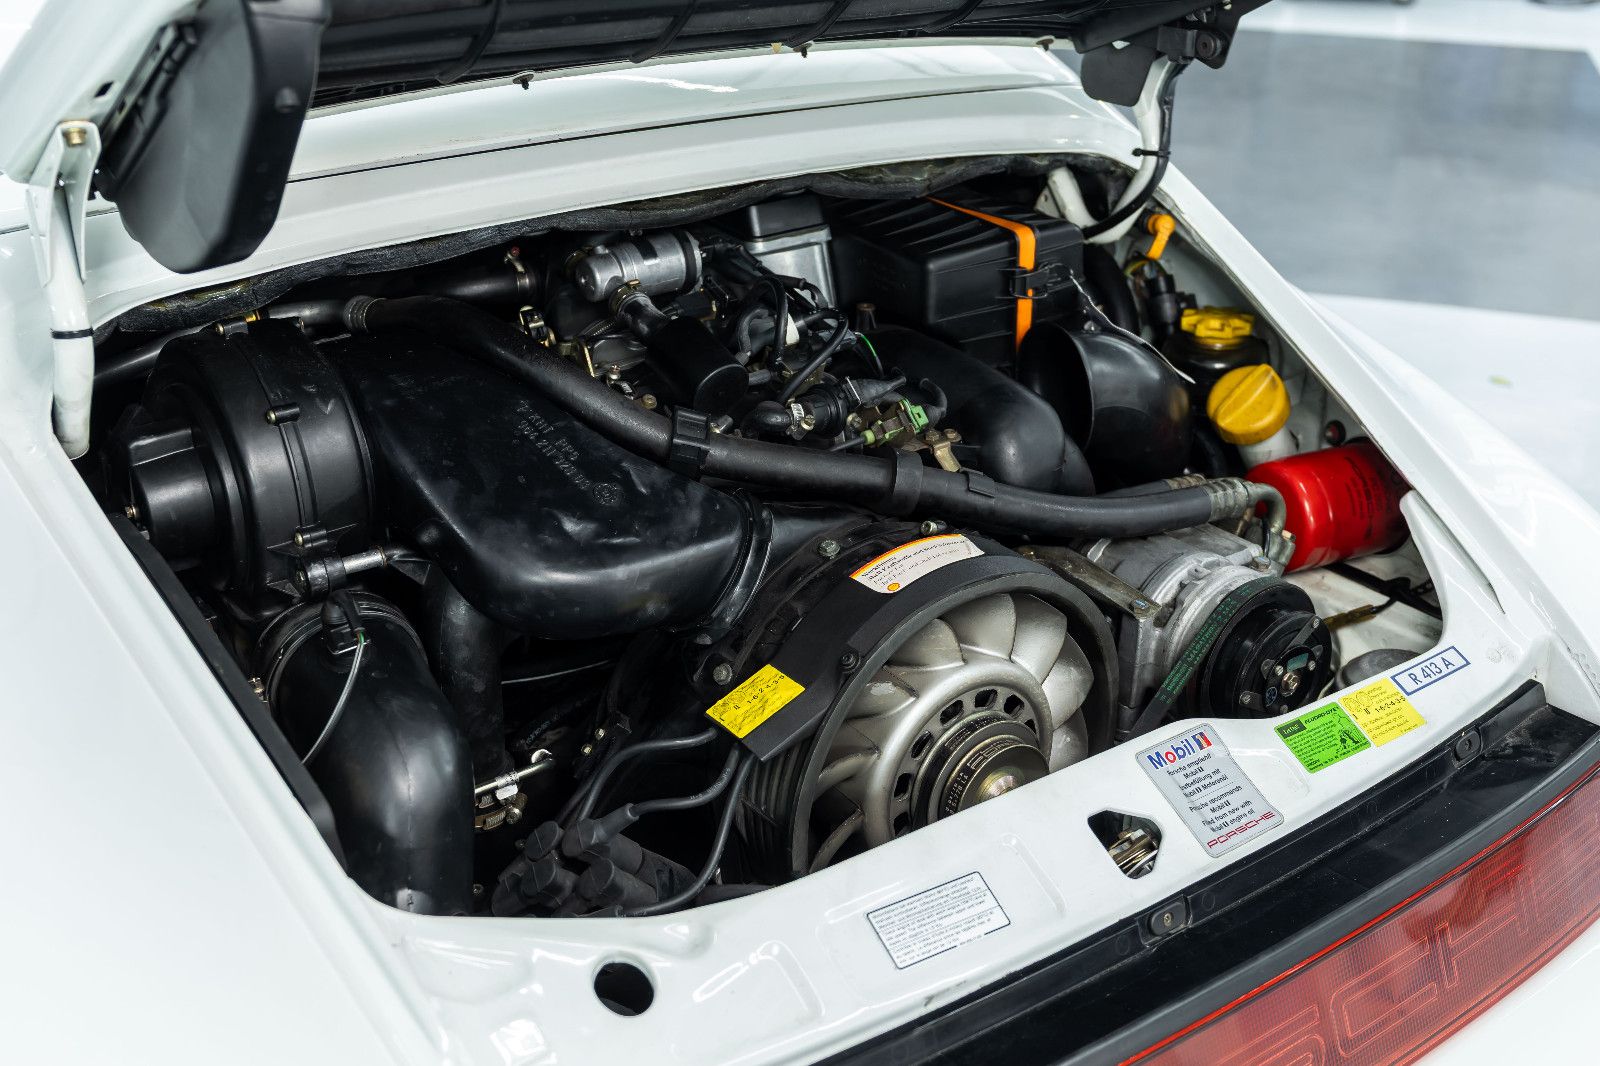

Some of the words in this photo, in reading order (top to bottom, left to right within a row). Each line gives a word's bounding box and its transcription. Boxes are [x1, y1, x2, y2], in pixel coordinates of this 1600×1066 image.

[1408, 672, 1422, 686] R
[1423, 662, 1443, 679] 413
[1443, 656, 1455, 670] A
[1146, 738, 1196, 769] Mobil
[1187, 753, 1212, 769] empfiehlt
[1183, 768, 1198, 779] Mobil
[1202, 774, 1228, 790] Motorenöl
[1209, 785, 1242, 804] recommends
[1210, 803, 1225, 814] Mobil
[1230, 813, 1248, 826] engine
[1207, 811, 1276, 848] PORSCHE
